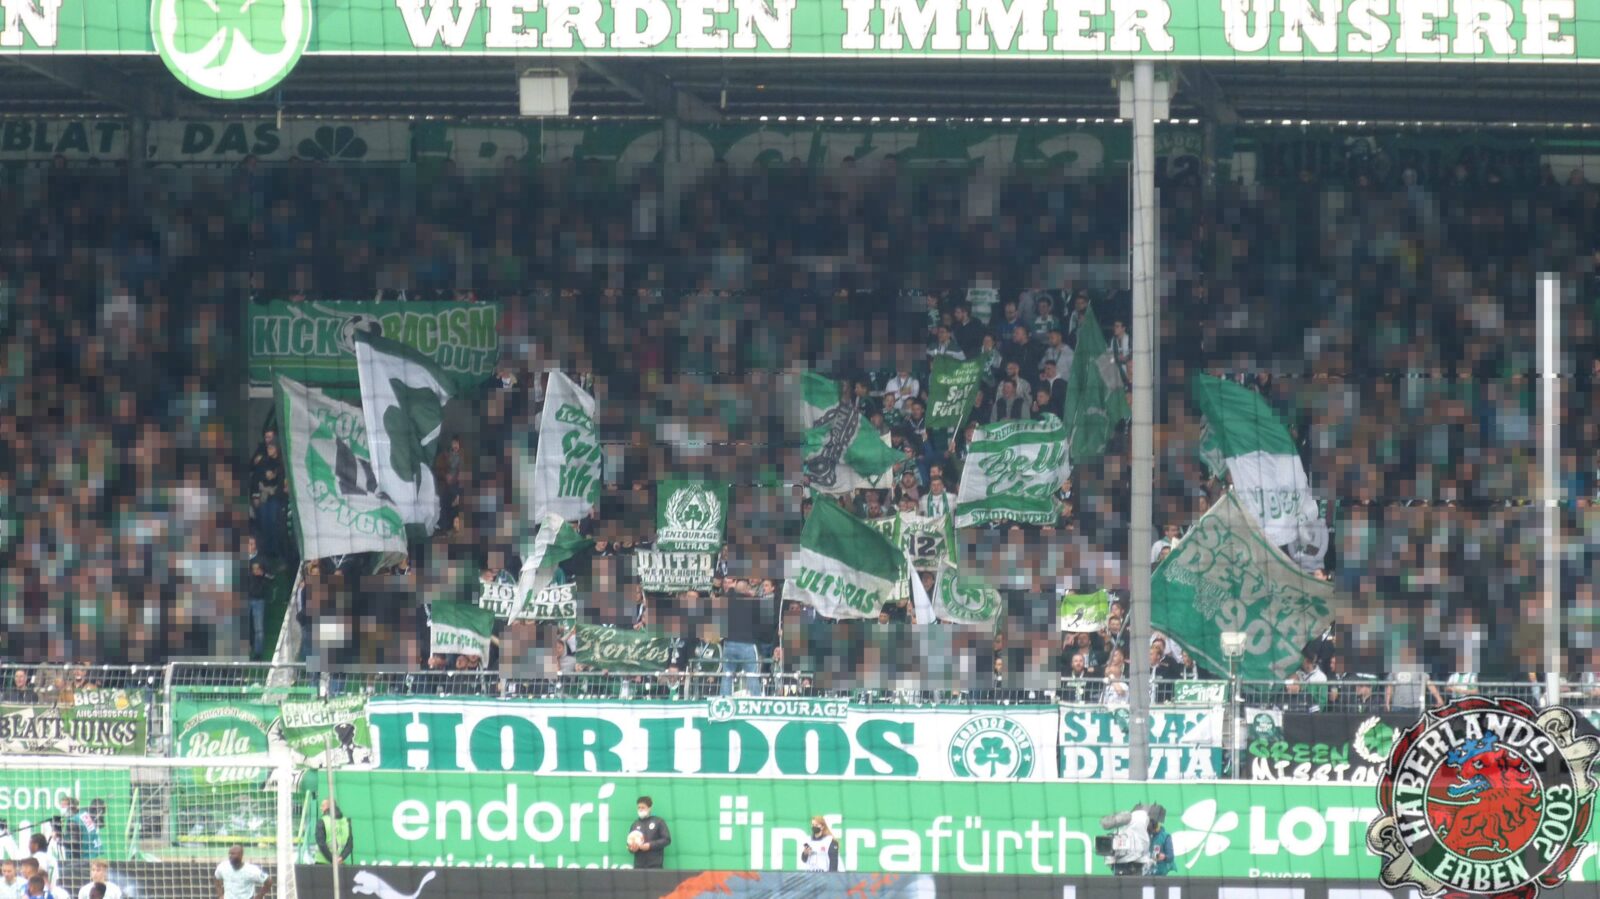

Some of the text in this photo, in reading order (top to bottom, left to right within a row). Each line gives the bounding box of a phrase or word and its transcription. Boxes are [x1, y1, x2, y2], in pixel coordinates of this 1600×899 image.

[400, 0, 792, 50] WERDEN
[842, 0, 1174, 52] IMMER
[1222, 0, 1577, 56] UNSERE
[180, 123, 281, 155] DAS
[252, 305, 498, 357] KICK RACISM
[664, 529, 718, 541] ENTOURAGE
[674, 542, 711, 551] ULTRAS
[908, 535, 936, 557] 12
[638, 551, 712, 571] UNITED
[483, 584, 573, 601] HODOS
[737, 701, 847, 717] ENTOURAGE
[285, 712, 335, 733] PFLICHT
[187, 728, 250, 759] Bella
[369, 711, 919, 776] HORIDOS
[1249, 738, 1350, 765] GREEN
[1249, 806, 1384, 856] LOTT
